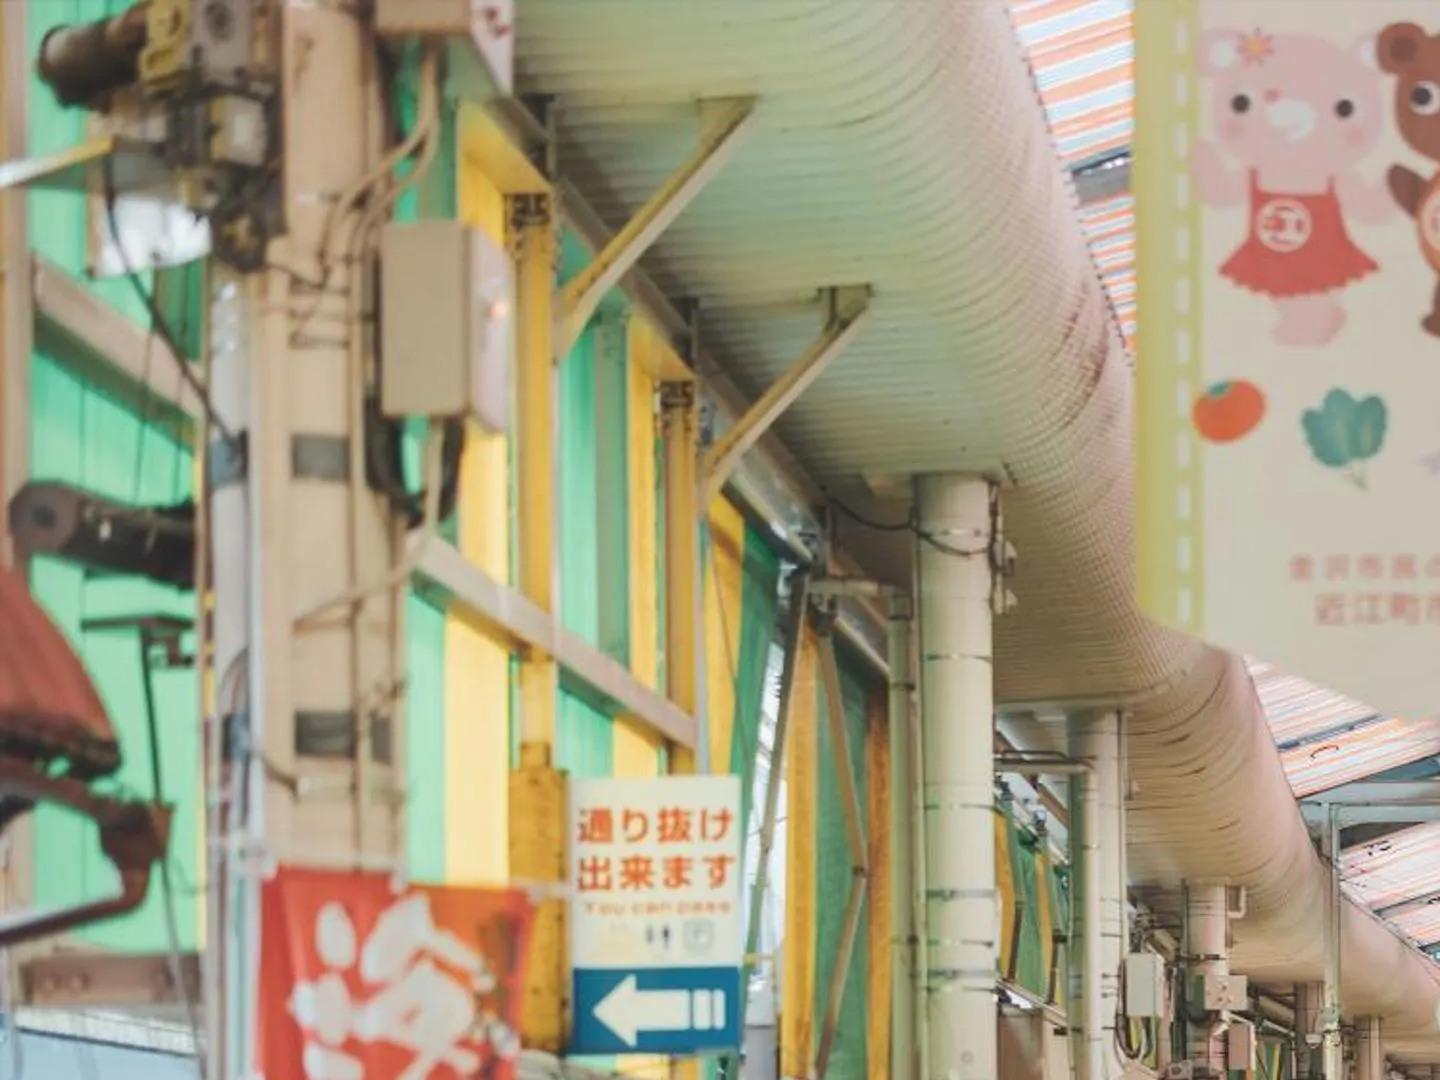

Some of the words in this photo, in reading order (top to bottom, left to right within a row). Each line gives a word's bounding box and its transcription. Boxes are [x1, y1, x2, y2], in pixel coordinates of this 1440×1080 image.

[577, 807, 735, 845] 通り抜け
[577, 853, 736, 893] 出来ます
